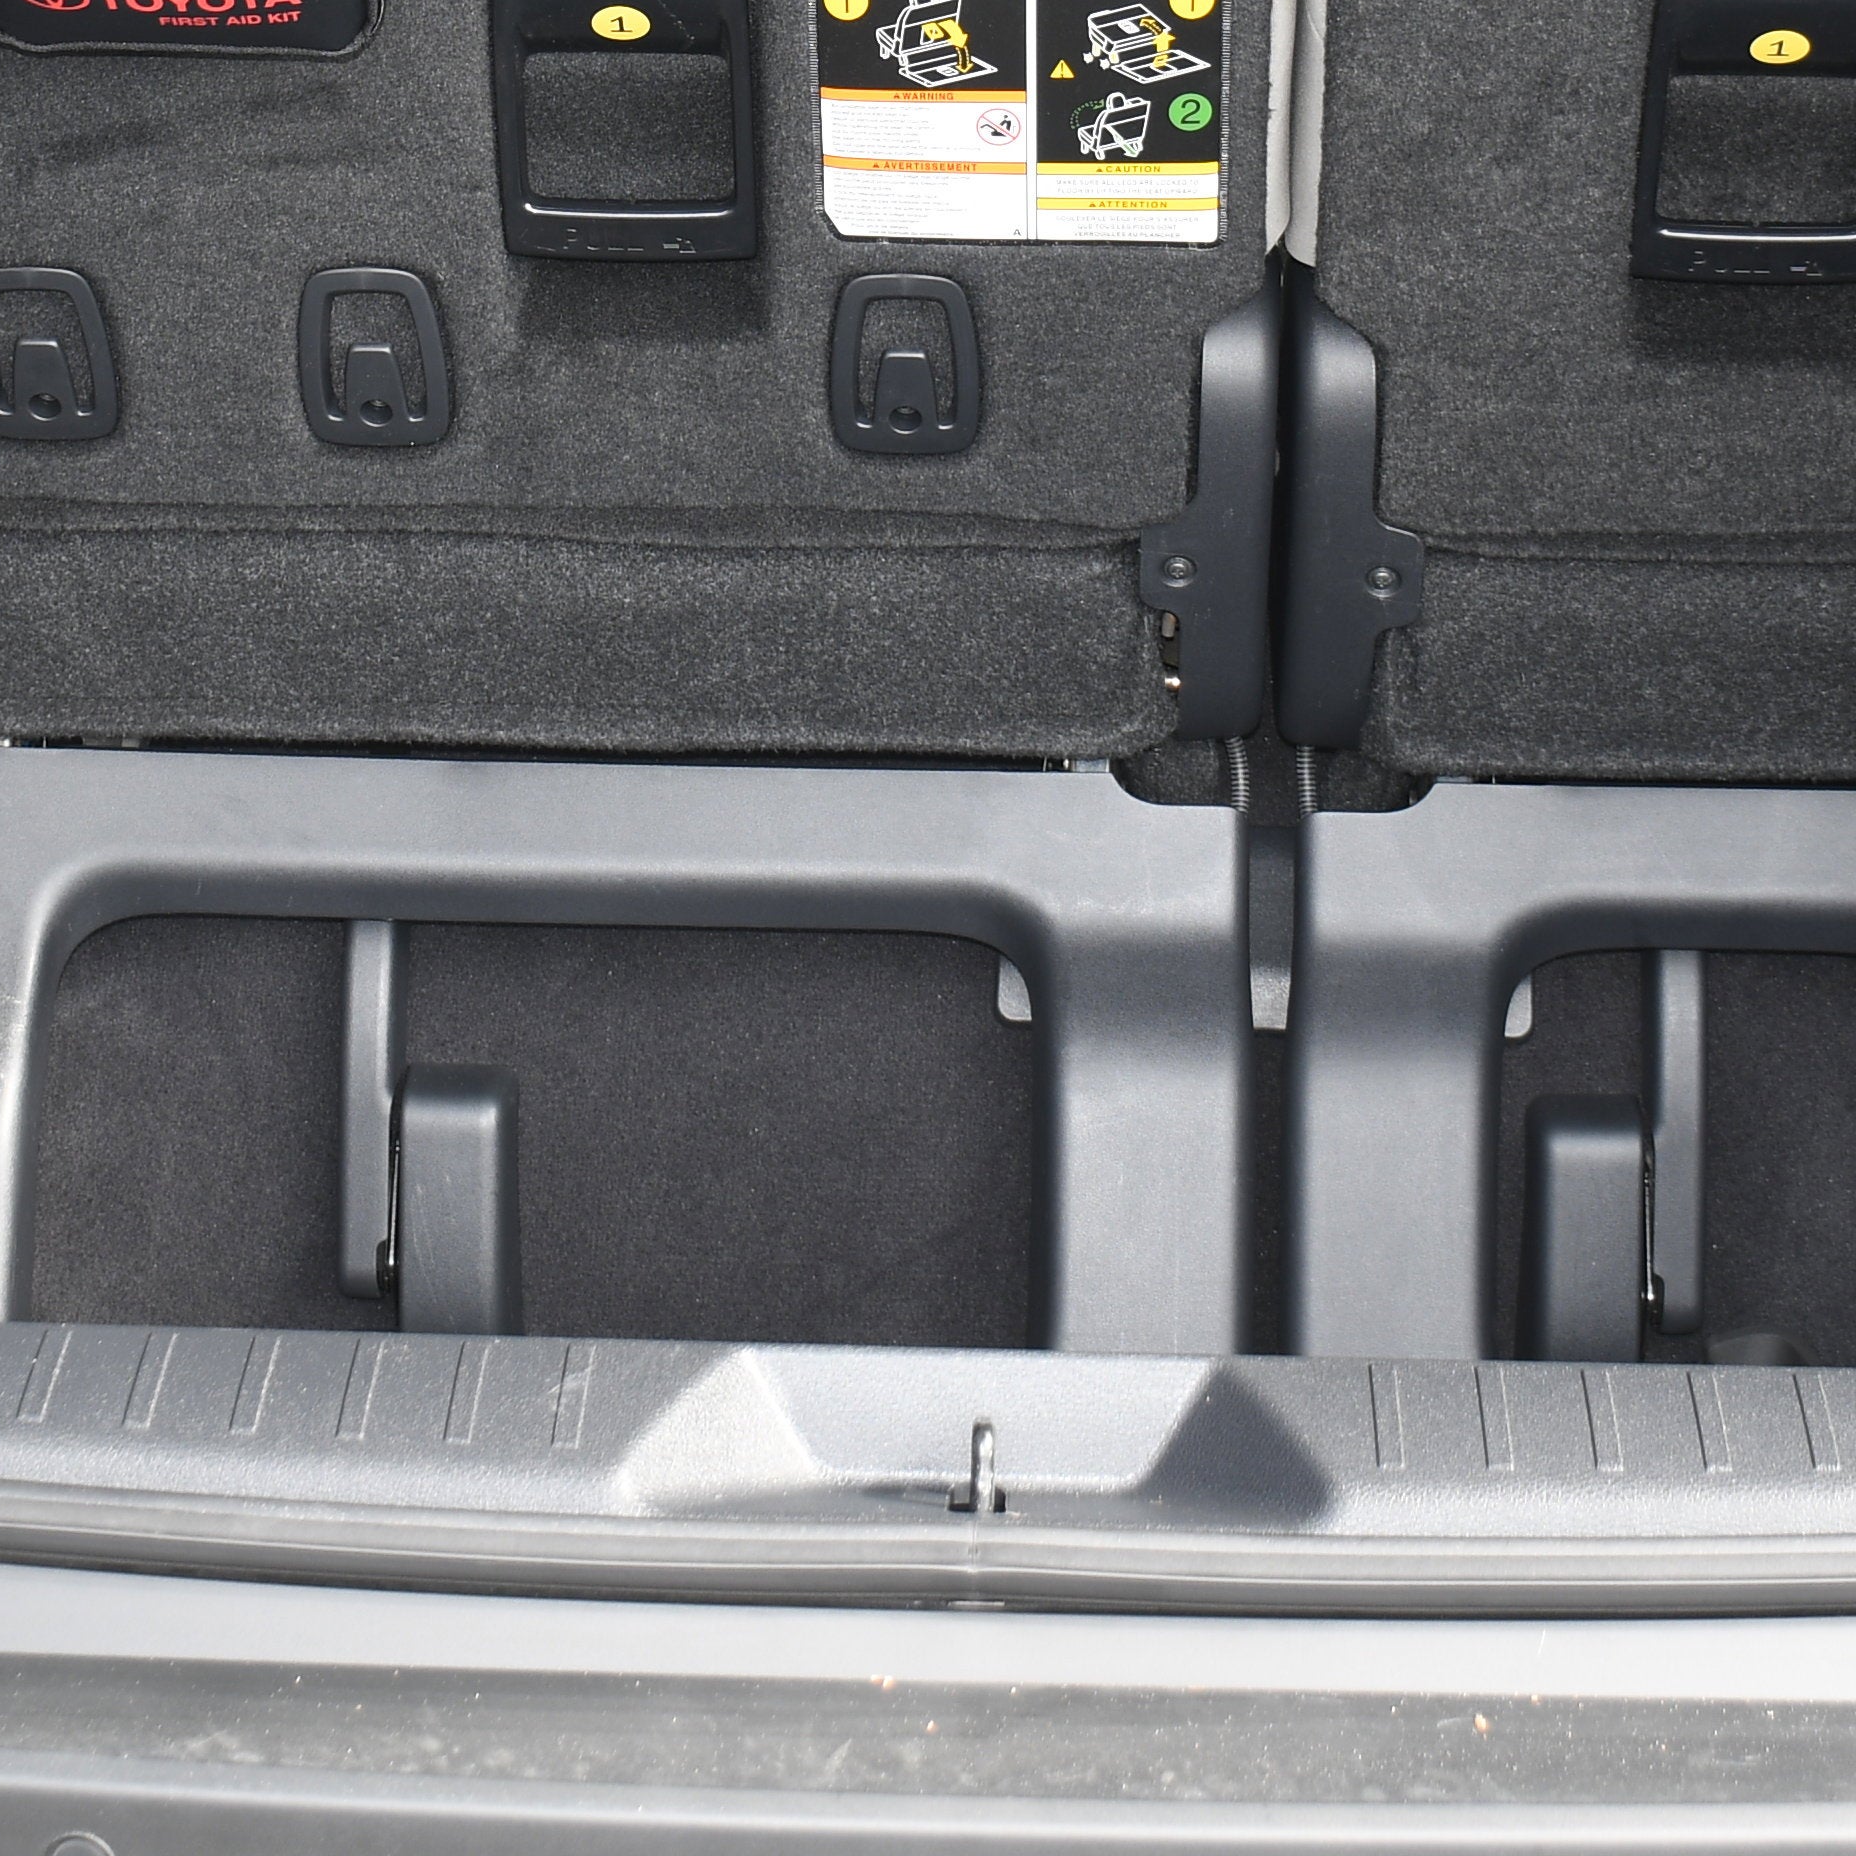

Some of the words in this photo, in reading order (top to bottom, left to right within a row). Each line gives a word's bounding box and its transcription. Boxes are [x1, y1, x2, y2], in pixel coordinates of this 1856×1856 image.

[158, 14, 219, 28] FIRST
[226, 12, 261, 27] AID
[267, 10, 302, 25] KIT
[609, 14, 634, 33] 1
[1766, 39, 1791, 57] 1
[901, 91, 955, 101] WARNING
[1180, 100, 1202, 125] 2
[883, 161, 979, 173] AVERTISSEMENT
[1105, 164, 1162, 174] CAUTION
[1098, 200, 1168, 210] ATTENTION
[1012, 228, 1022, 237] A
